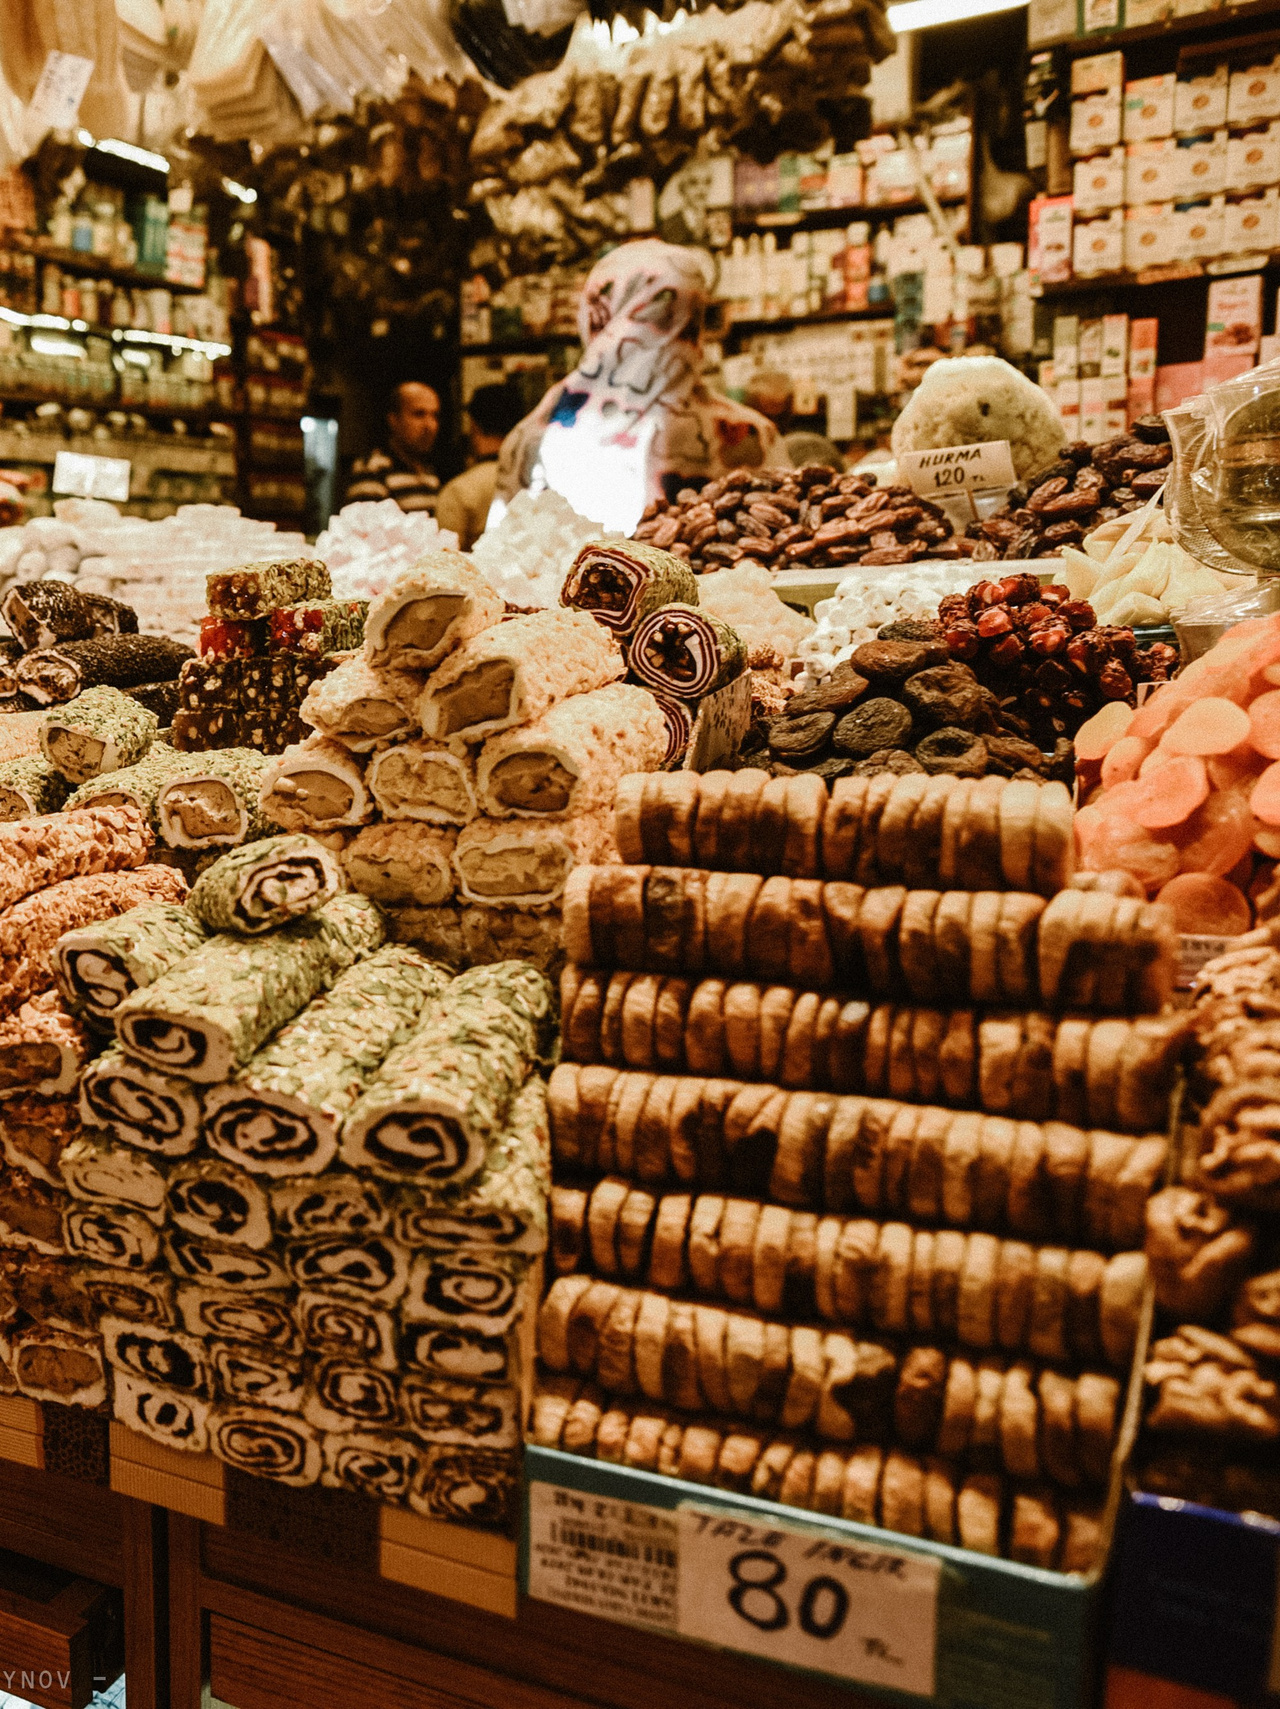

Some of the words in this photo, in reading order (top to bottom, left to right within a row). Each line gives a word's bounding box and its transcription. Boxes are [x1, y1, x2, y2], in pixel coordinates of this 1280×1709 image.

[920, 449, 981, 468] HURMA
[934, 467, 965, 487] 120
[727, 1549, 850, 1641] 80
